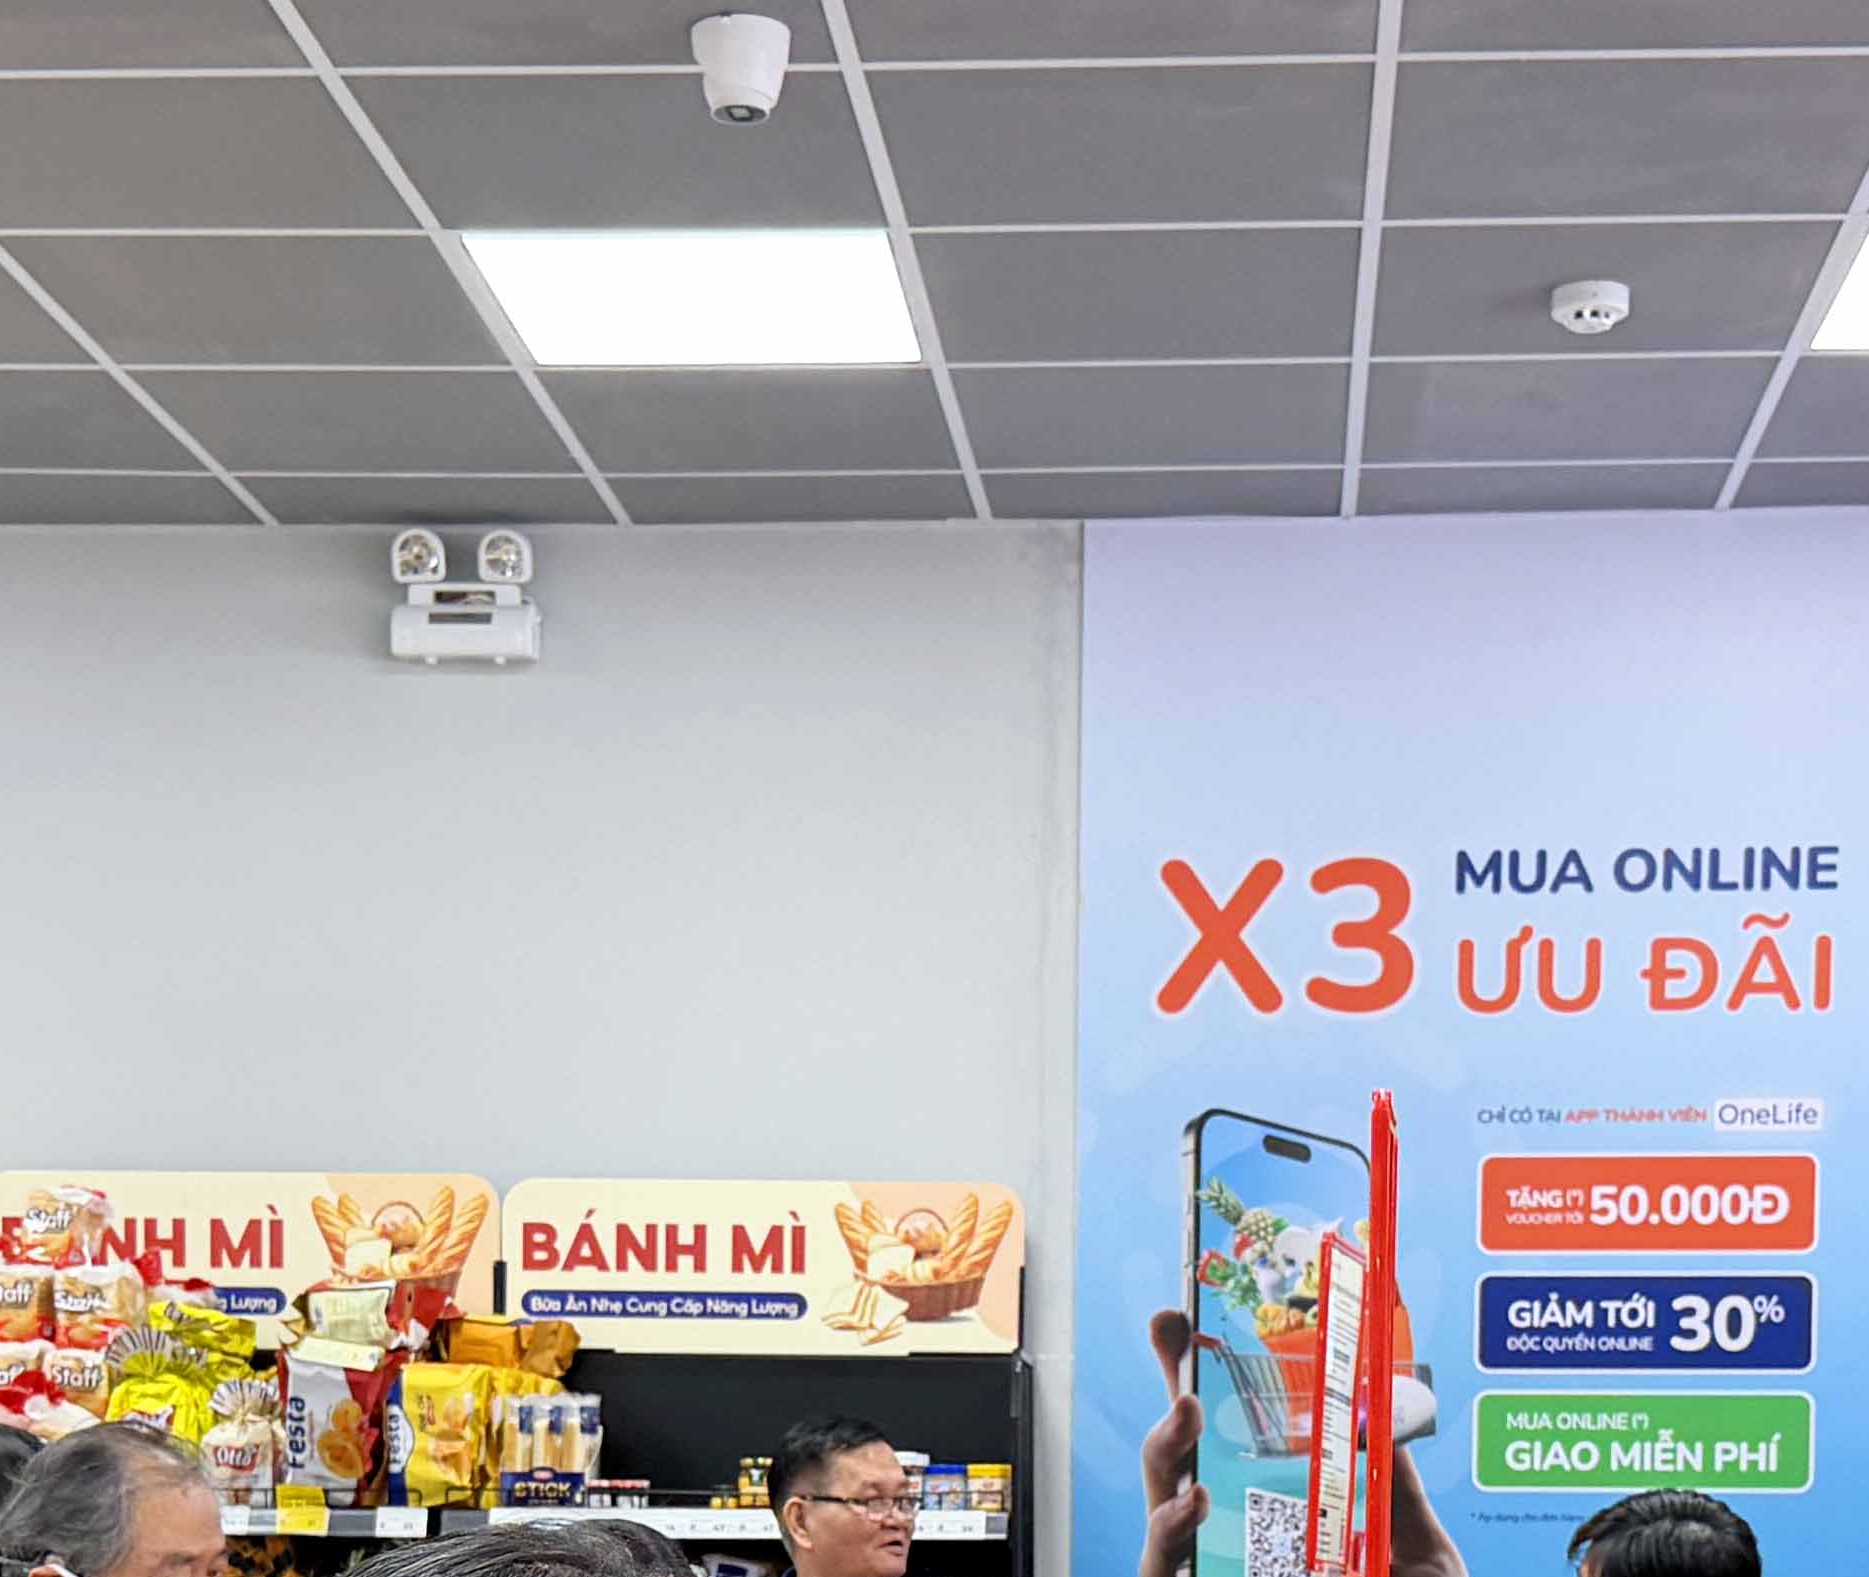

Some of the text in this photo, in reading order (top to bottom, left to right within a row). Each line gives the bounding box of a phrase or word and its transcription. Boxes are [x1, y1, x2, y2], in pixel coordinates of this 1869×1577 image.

[1455, 845, 1840, 895] MUA ONLINE
[1155, 856, 1416, 1015] X3
[1455, 911, 1834, 1014] ƯU ĐÃI
[1718, 1103, 1818, 1127] OneLife
[1590, 1185, 1791, 1226] 50.000Đ
[210, 1204, 285, 1269] MÌ
[522, 1209, 807, 1275] BÁNH MÌ
[625, 1298, 668, 1319] Cung
[1507, 1292, 1786, 1352] GIẢM TỚI 30%
[1599, 1335, 1653, 1352] ONLINE
[50, 1363, 103, 1387] Staff
[1506, 1412, 1628, 1431] MUA ONLINE
[1504, 1429, 1781, 1472] GIAO MIỄN PHÍ
[514, 1482, 572, 1498] STICK
